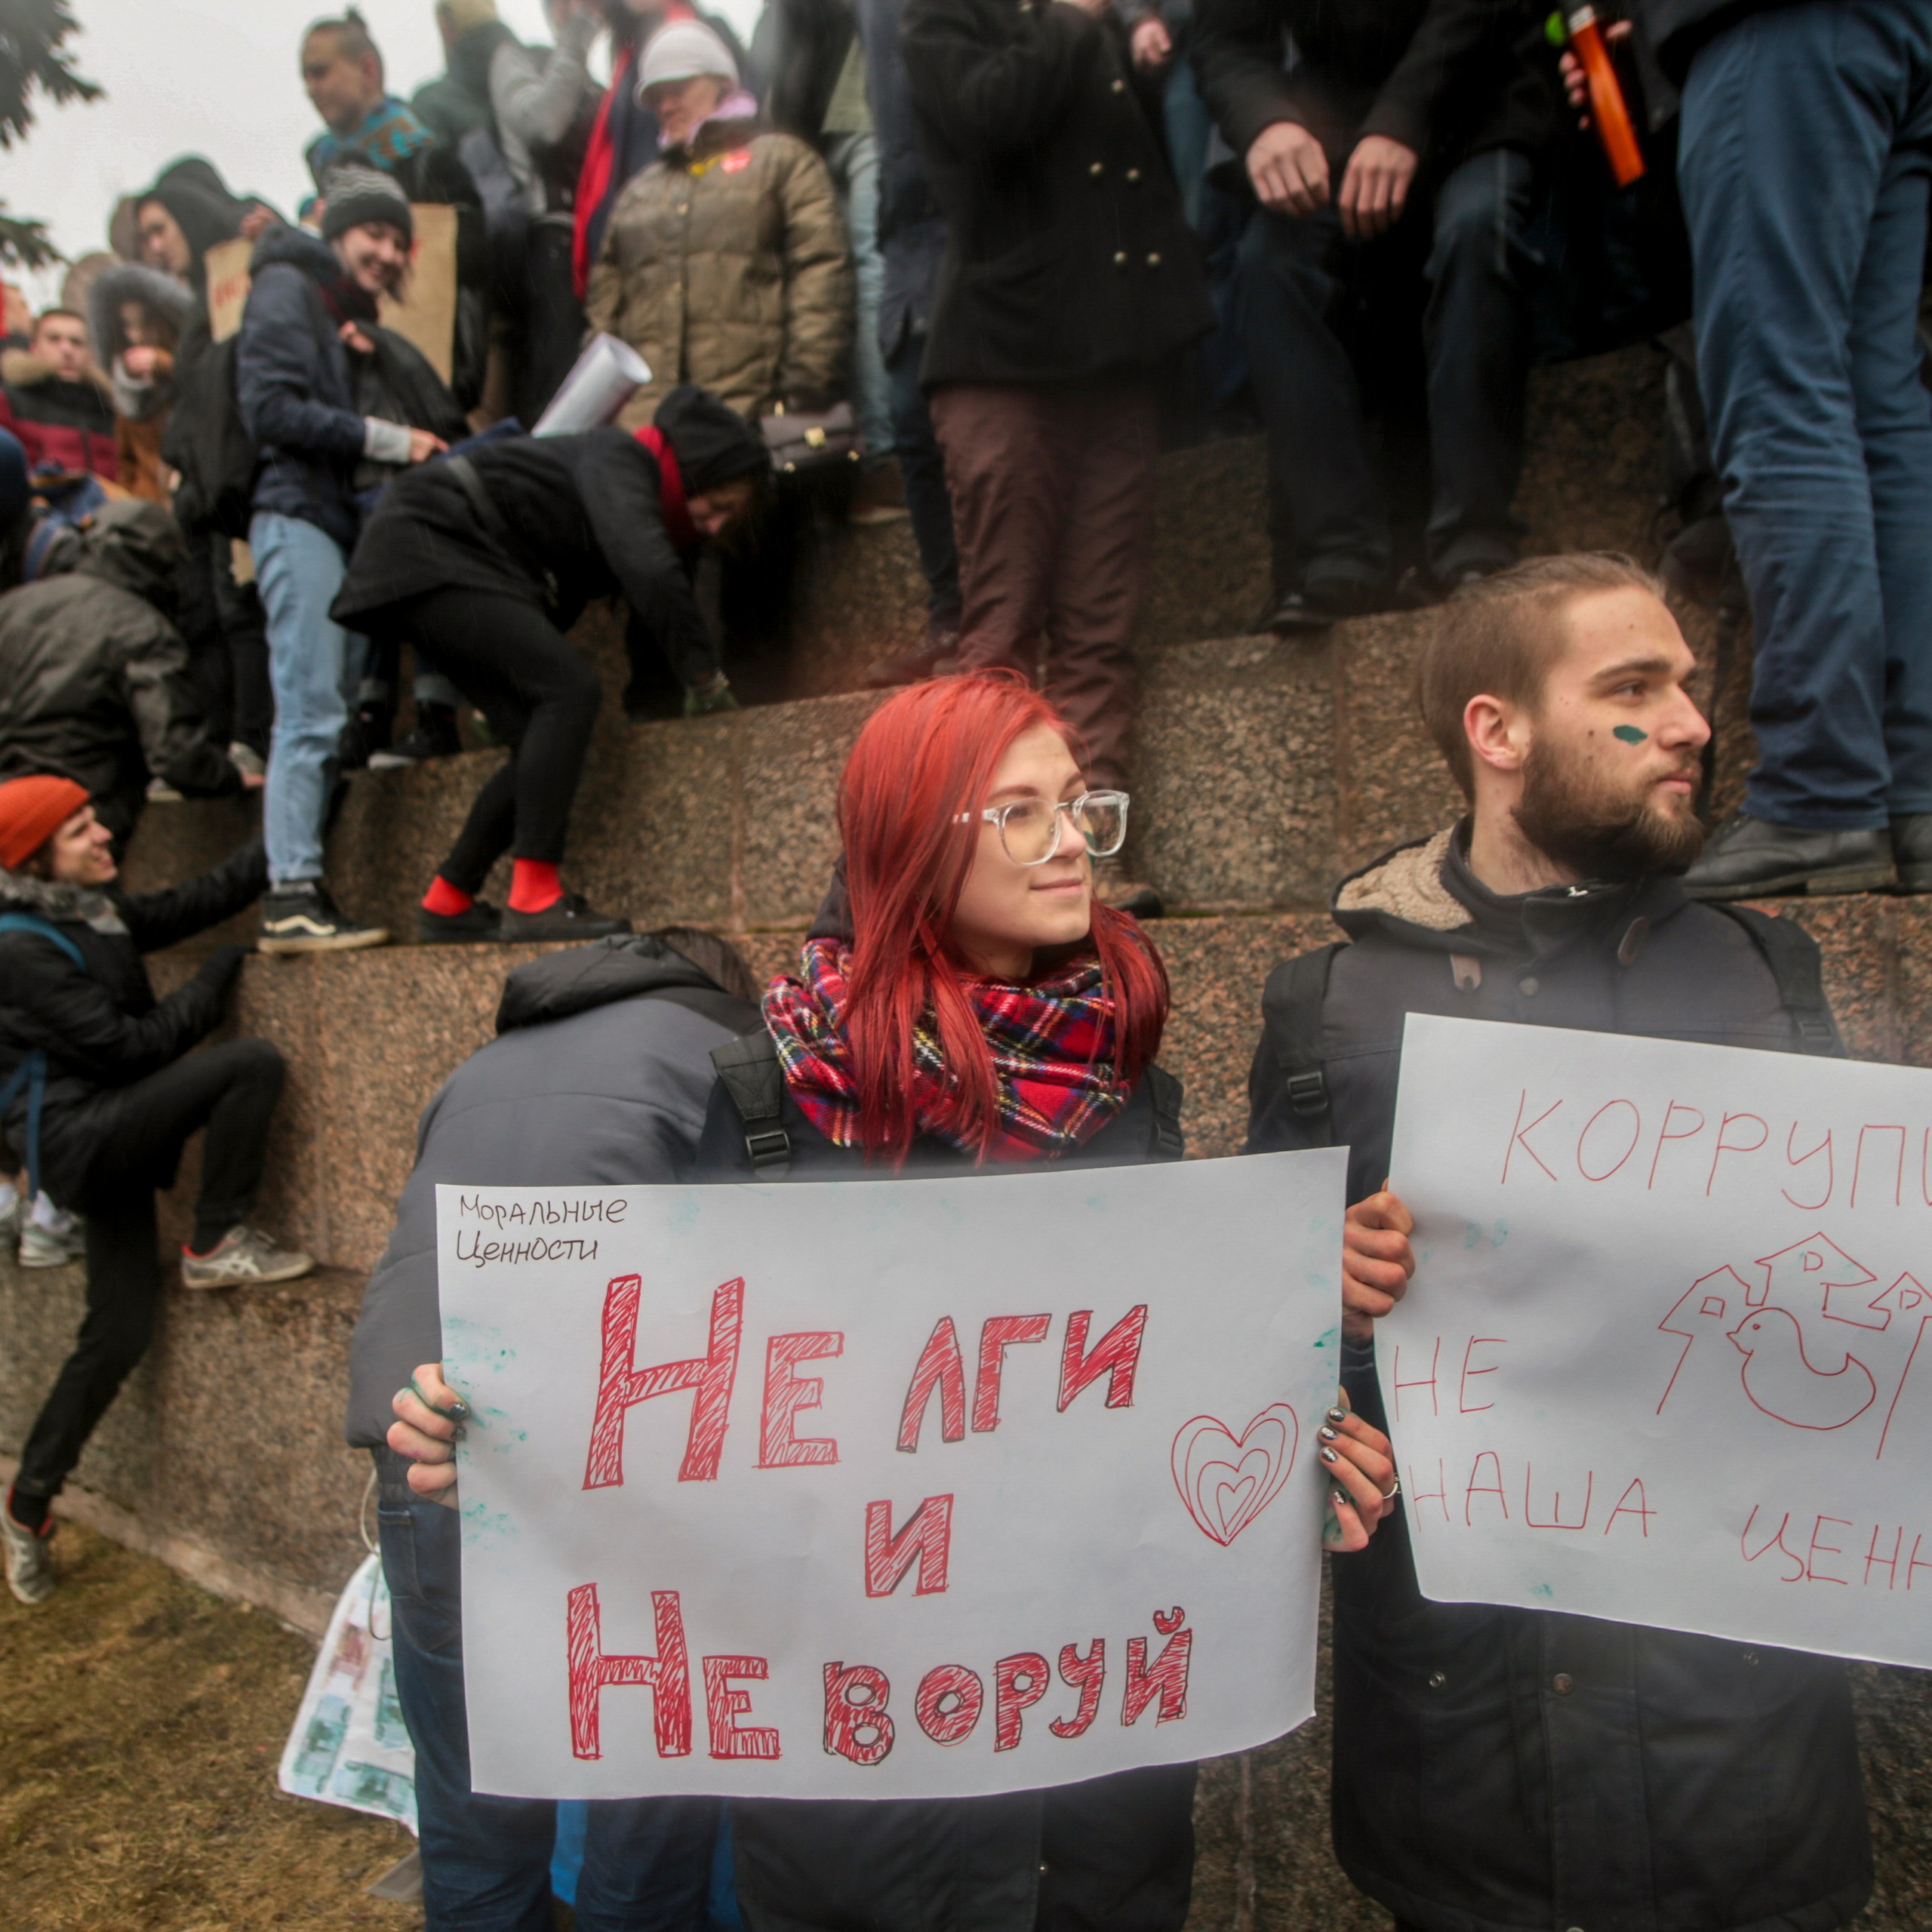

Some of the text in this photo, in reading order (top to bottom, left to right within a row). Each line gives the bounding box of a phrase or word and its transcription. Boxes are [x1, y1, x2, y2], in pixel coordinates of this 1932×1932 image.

[1501, 1089, 1932, 1211] КОРРУП
[455, 1229, 598, 1268] Ценности
[460, 1194, 628, 1229] Моральные
[1395, 1335, 1510, 1422] НЕ
[1408, 1451, 1658, 1538] НАША
